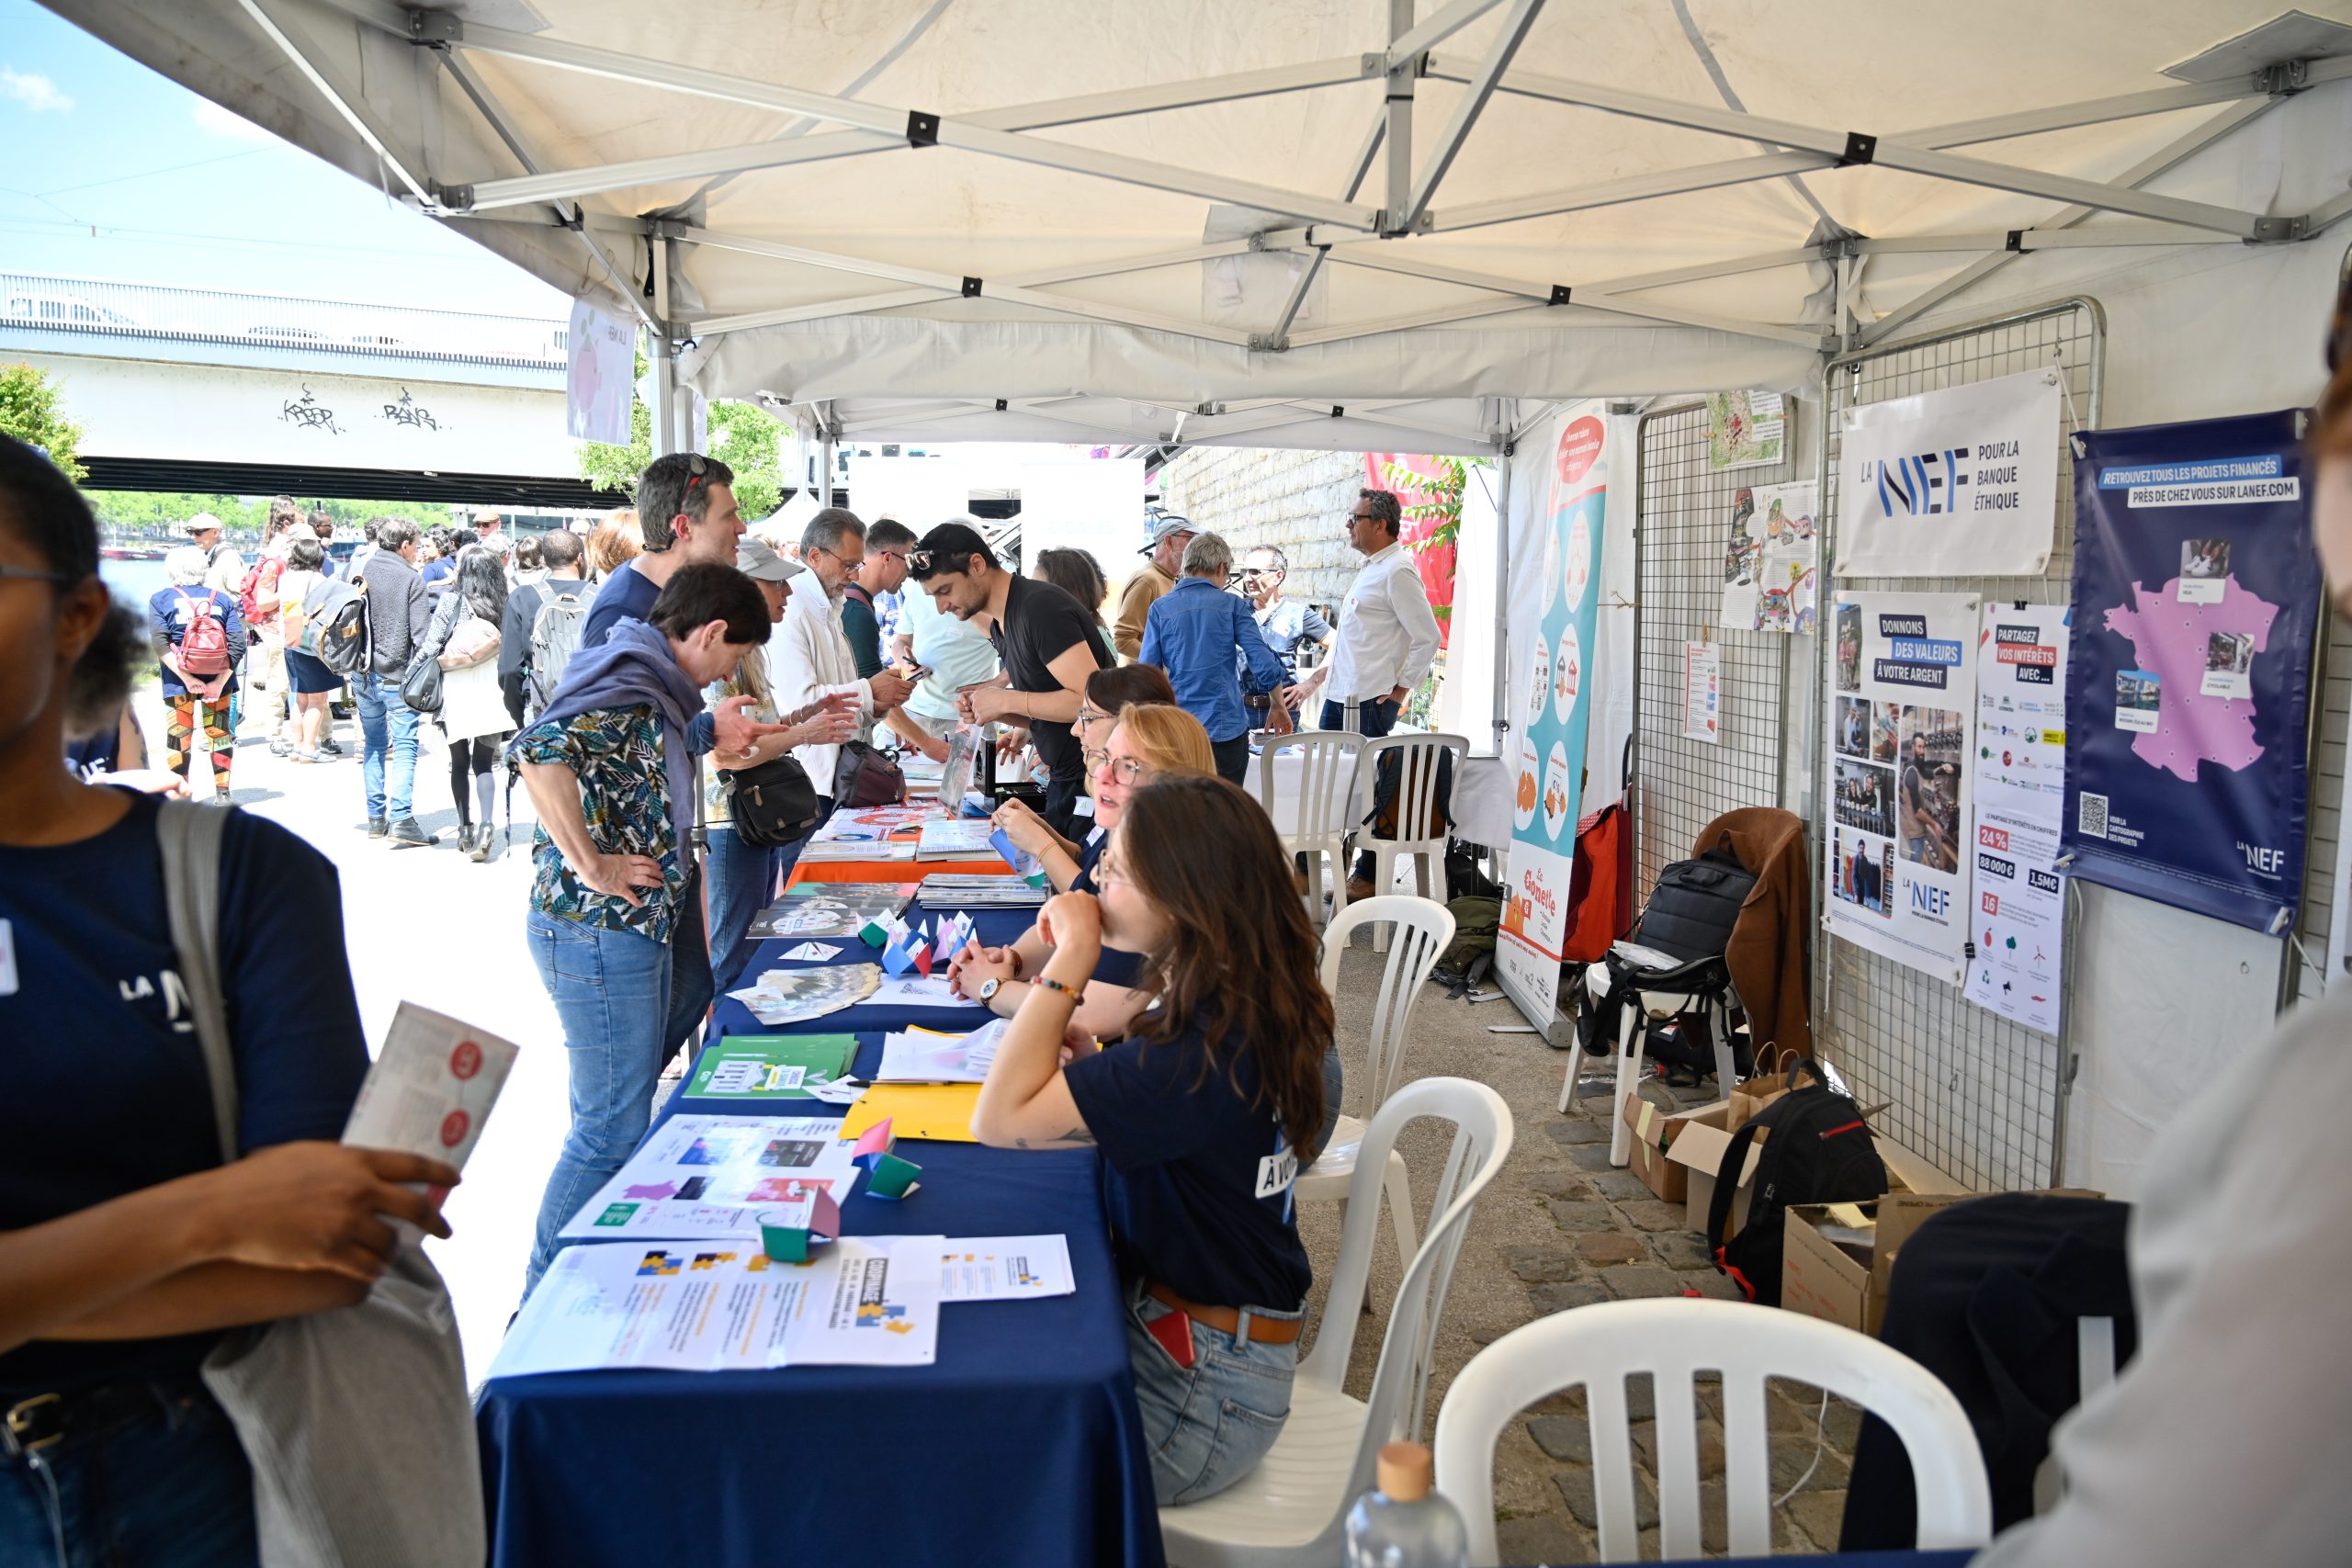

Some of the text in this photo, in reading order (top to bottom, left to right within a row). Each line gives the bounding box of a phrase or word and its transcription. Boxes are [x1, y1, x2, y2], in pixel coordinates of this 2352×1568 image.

[1979, 440, 2019, 460] POUR LA
[1977, 467, 2018, 486] BANQUE
[2104, 457, 2277, 485] RETROUVEZ TOUS LES PROJETS FINANCÉS
[1860, 448, 1969, 517] LA NEF
[2132, 482, 2294, 503] PRÈS DE CHEZ VOUS SUR LANEF.COM
[1974, 491, 2019, 511] ÉTHIQUE
[1882, 619, 1924, 636] DONNONS
[1997, 628, 2037, 643] PARTAGEZ
[1894, 641, 1958, 663] DES VALEURS
[1998, 647, 2054, 664] VOS INTÉRÊTS
[1877, 664, 1943, 684] À VOTRE ARGENT
[2018, 668, 2041, 681] AVEC
[1990, 814, 2007, 824] PARTAGE
[2036, 825, 2058, 837] CHIFFRES
[2109, 815, 2120, 825] VOIR
[1981, 829, 1995, 845] 24
[1995, 832, 2007, 849] %
[2109, 824, 2144, 840] CARTOGRAPHIE
[2109, 833, 2138, 847] DES PROJETS
[1979, 855, 1990, 869] 88
[1990, 859, 2006, 874] 000
[2236, 840, 2285, 873] LA NEF
[2030, 872, 2057, 890] 1,5M€
[1524, 869, 1556, 917] Gonette
[1903, 877, 1950, 917] LA NEF
[1983, 895, 1996, 912] 16
[119, 976, 154, 1000] LA
[862, 1259, 885, 1303] COOPINAGE
